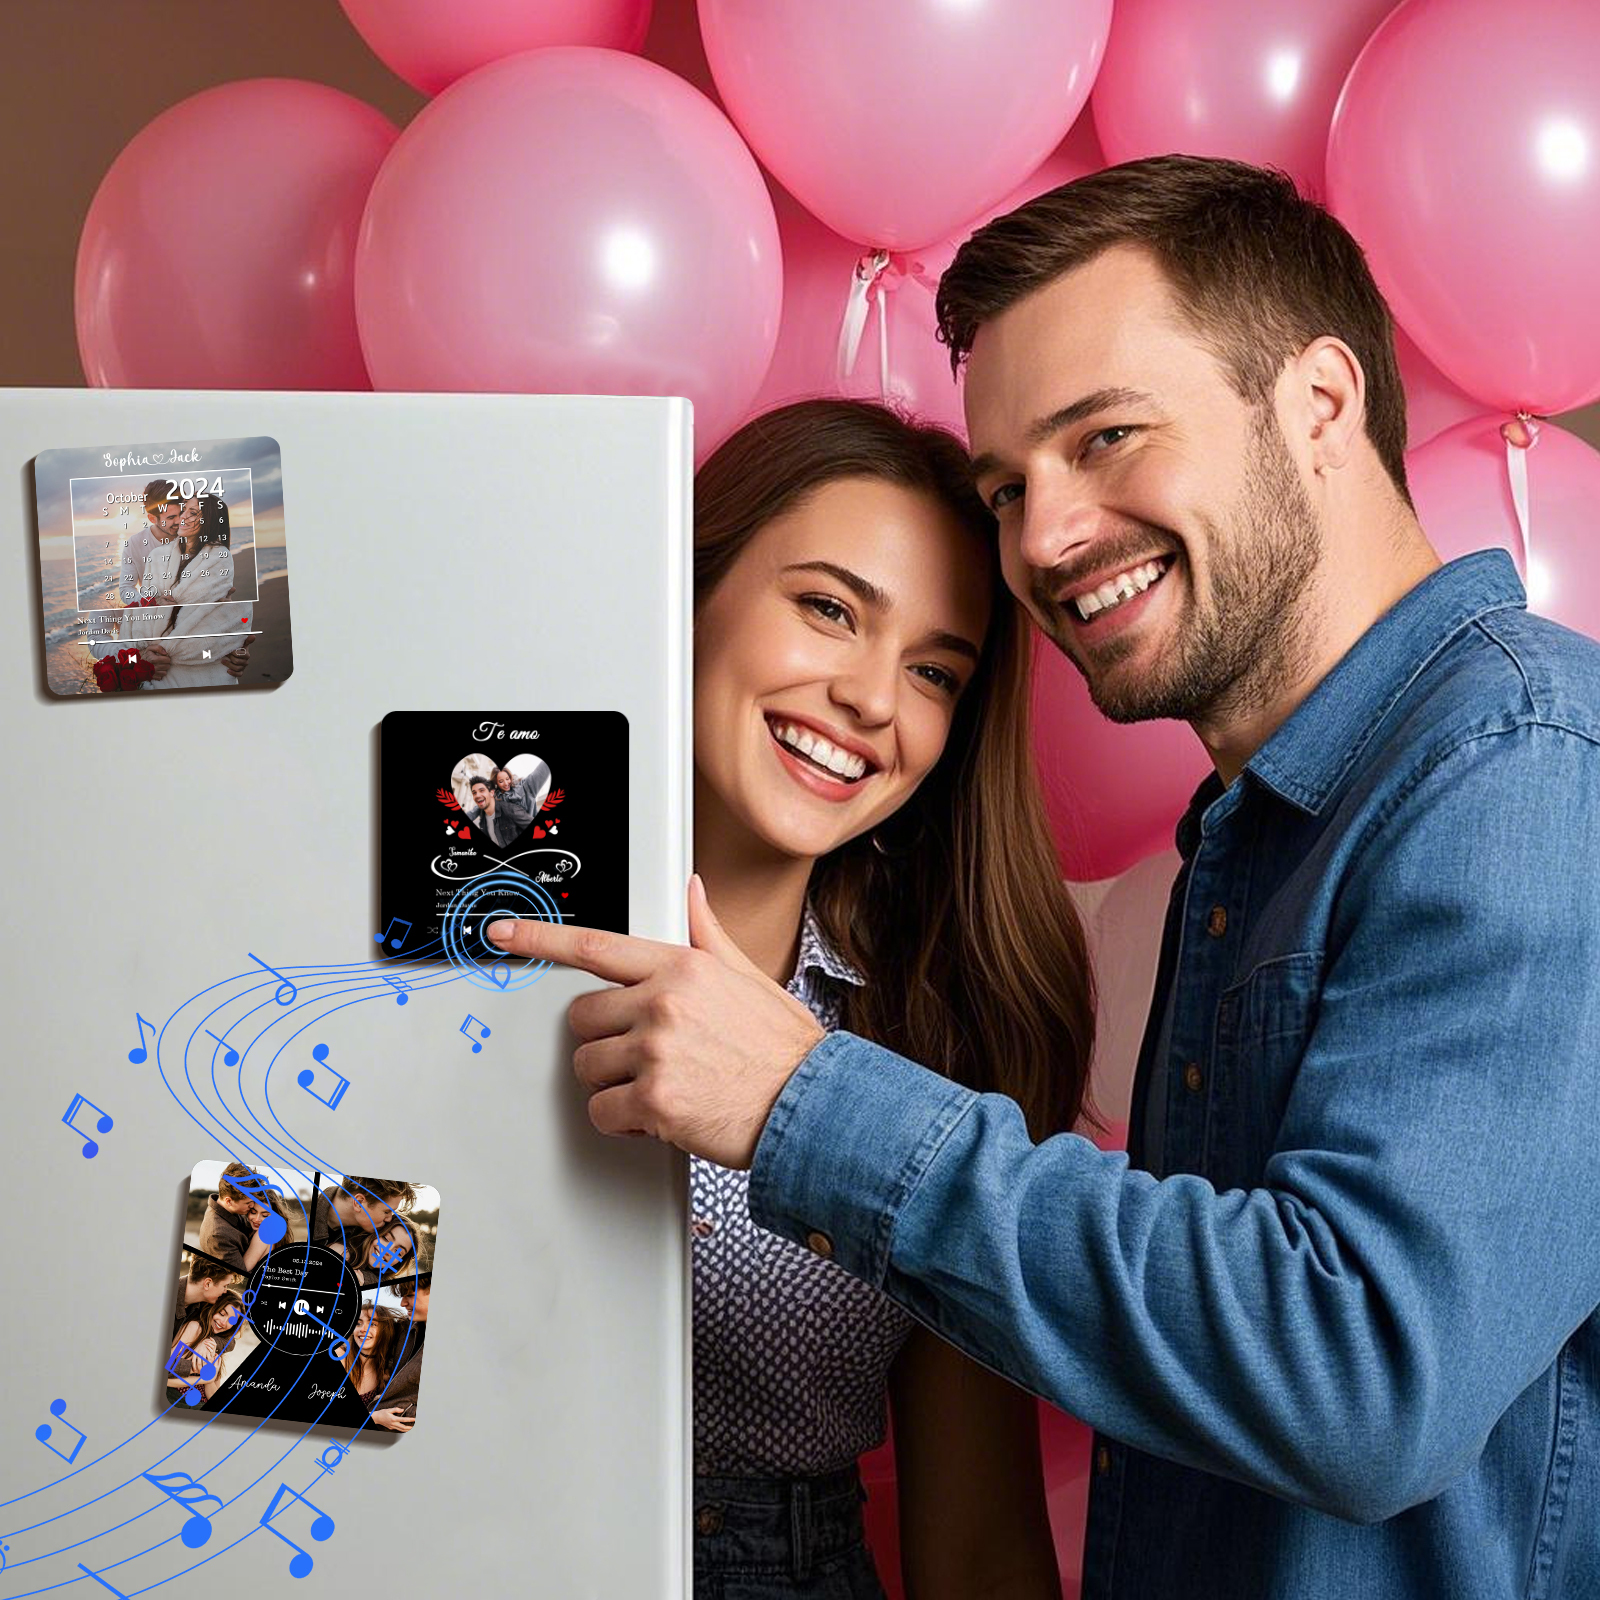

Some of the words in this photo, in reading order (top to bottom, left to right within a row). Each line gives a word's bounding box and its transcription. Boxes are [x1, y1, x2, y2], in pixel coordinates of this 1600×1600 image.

[103, 452, 150, 472] Sophia
[168, 447, 202, 464] Jack
[106, 492, 149, 505] October
[165, 477, 225, 501] 2024
[102, 507, 109, 517] S
[120, 506, 129, 516] M
[140, 505, 146, 514] T
[158, 503, 168, 513] W
[179, 502, 186, 512] T
[198, 501, 204, 511] F
[217, 500, 223, 510] S
[160, 537, 170, 545] 10
[104, 558, 113, 566] 14
[181, 570, 191, 578] 25
[200, 569, 210, 577] 26
[219, 568, 229, 576] 27
[105, 592, 115, 600] 28
[125, 591, 135, 599] 29
[77, 617, 96, 625] Next
[99, 615, 123, 625] Thing
[124, 614, 140, 622] You
[142, 612, 165, 621] Know
[472, 721, 505, 742] Te
[509, 728, 540, 740] amo
[435, 888, 454, 896] Next
[455, 888, 479, 898] Thing
[481, 888, 496, 896] You
[498, 888, 520, 896] Know
[277, 1266, 293, 1275] Best
[228, 1374, 281, 1391] Amanda
[307, 1383, 347, 1402] Joseph
